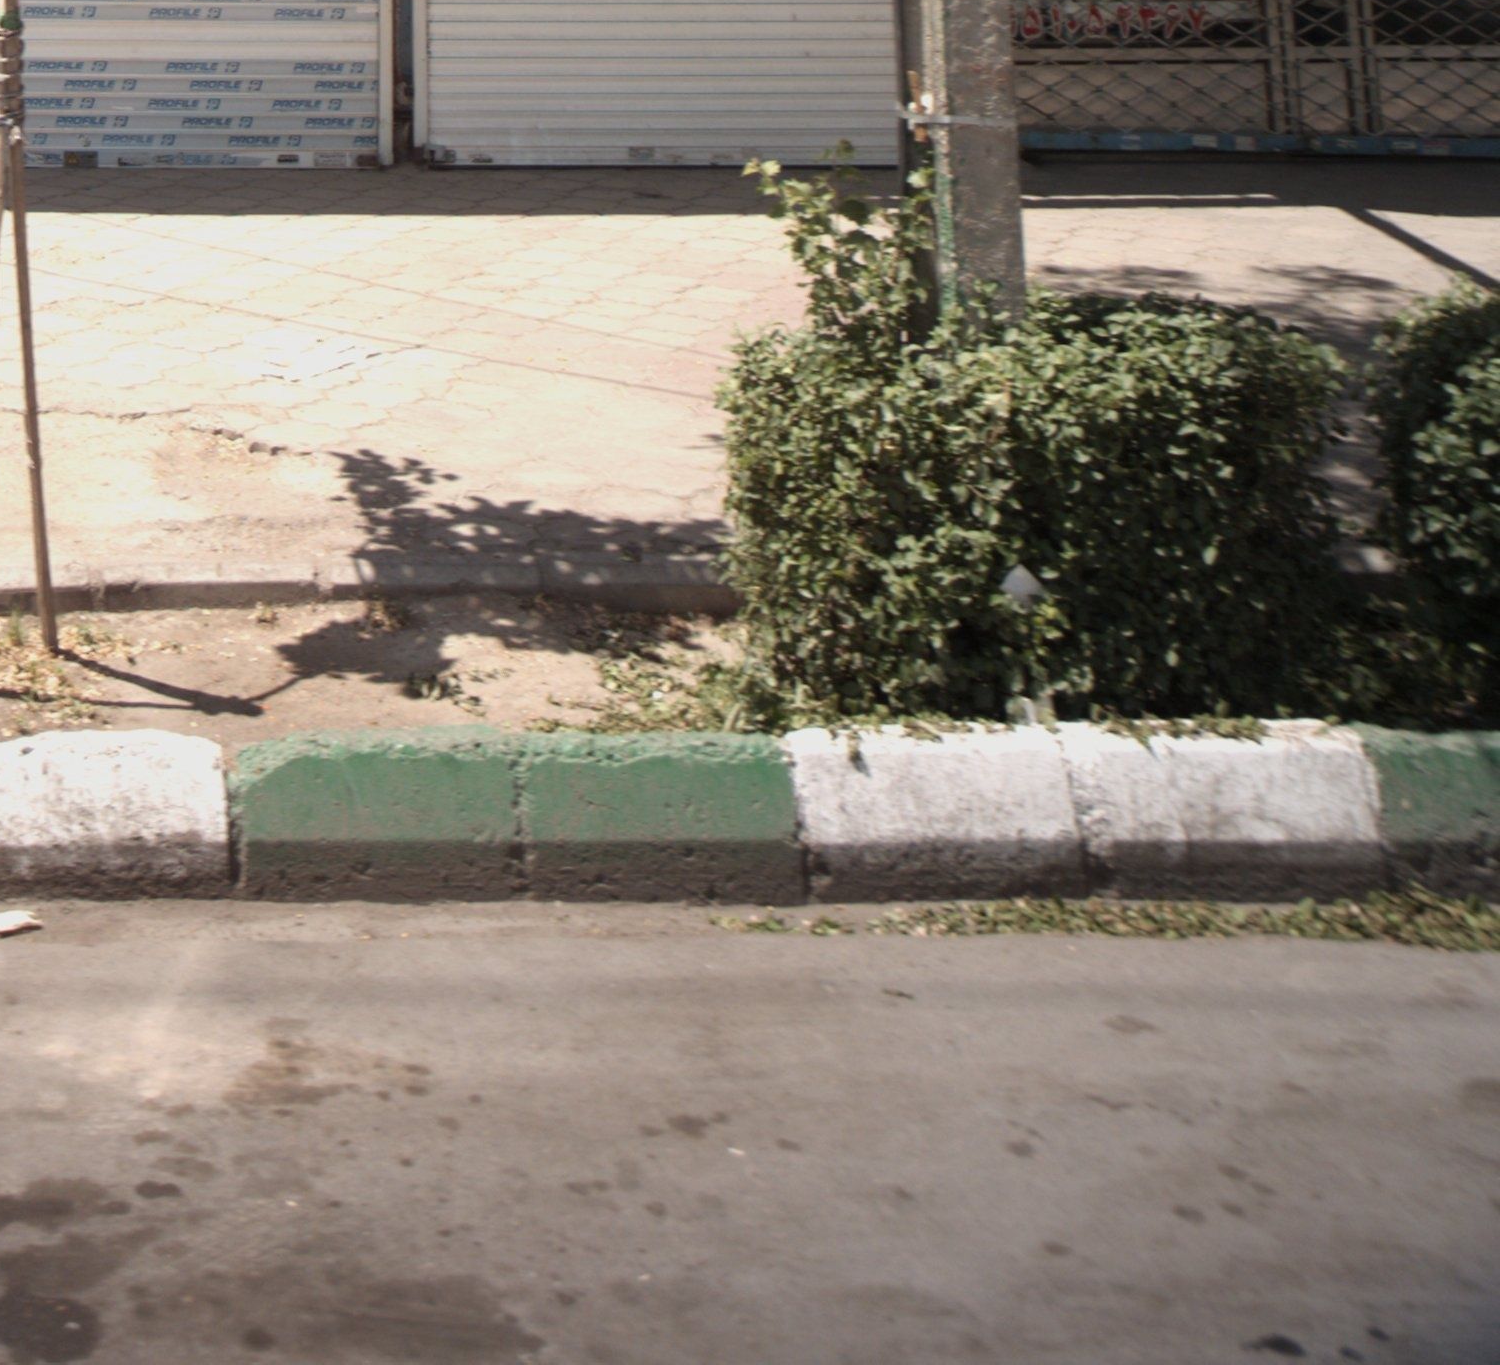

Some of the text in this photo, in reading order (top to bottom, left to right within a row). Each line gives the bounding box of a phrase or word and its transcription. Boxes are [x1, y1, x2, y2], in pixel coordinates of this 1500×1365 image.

[25, 6, 76, 16] PROFILE
[150, 7, 201, 17] PROFILE
[274, 8, 325, 18] PROFILE
[294, 61, 344, 71] PROFILE
[315, 79, 365, 89] PROFILE
[149, 98, 200, 108] PROFILE
[272, 98, 322, 108] PROFILE
[56, 115, 107, 125] PROFILE
[182, 116, 233, 126] PROFILE
[305, 116, 355, 126] PROFILE
